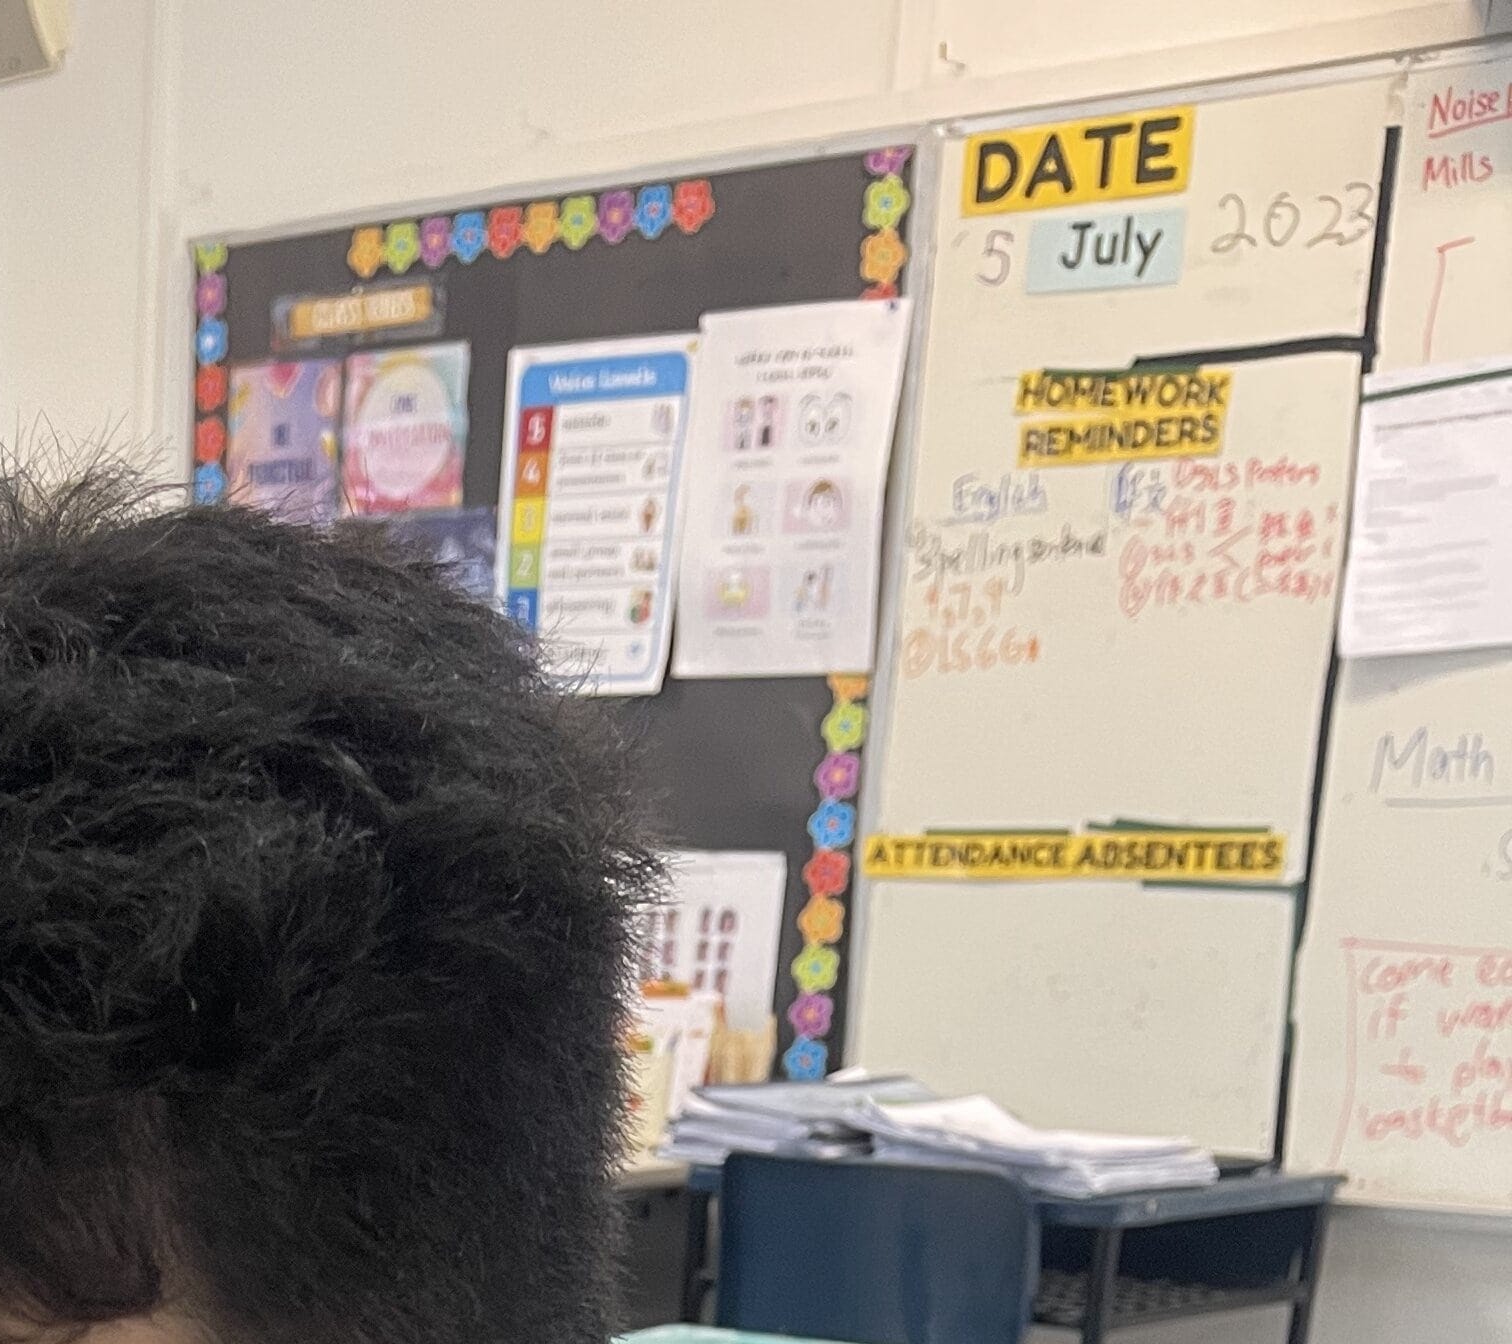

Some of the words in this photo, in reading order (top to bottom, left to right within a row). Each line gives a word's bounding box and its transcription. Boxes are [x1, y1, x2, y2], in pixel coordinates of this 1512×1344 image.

[1427, 85, 1500, 131] Noise
[975, 116, 1184, 204] DATE
[1421, 150, 1494, 191] Mills
[974, 228, 1015, 287] 5
[1060, 215, 1163, 278] July
[1210, 181, 1376, 255] 2023
[1020, 373, 1228, 408] HOMEWORK
[1022, 414, 1218, 458] REMINDERS
[1368, 726, 1494, 794] Math
[867, 840, 1068, 871] ATTENDANCE
[1082, 838, 1284, 873] ABSENTEES
